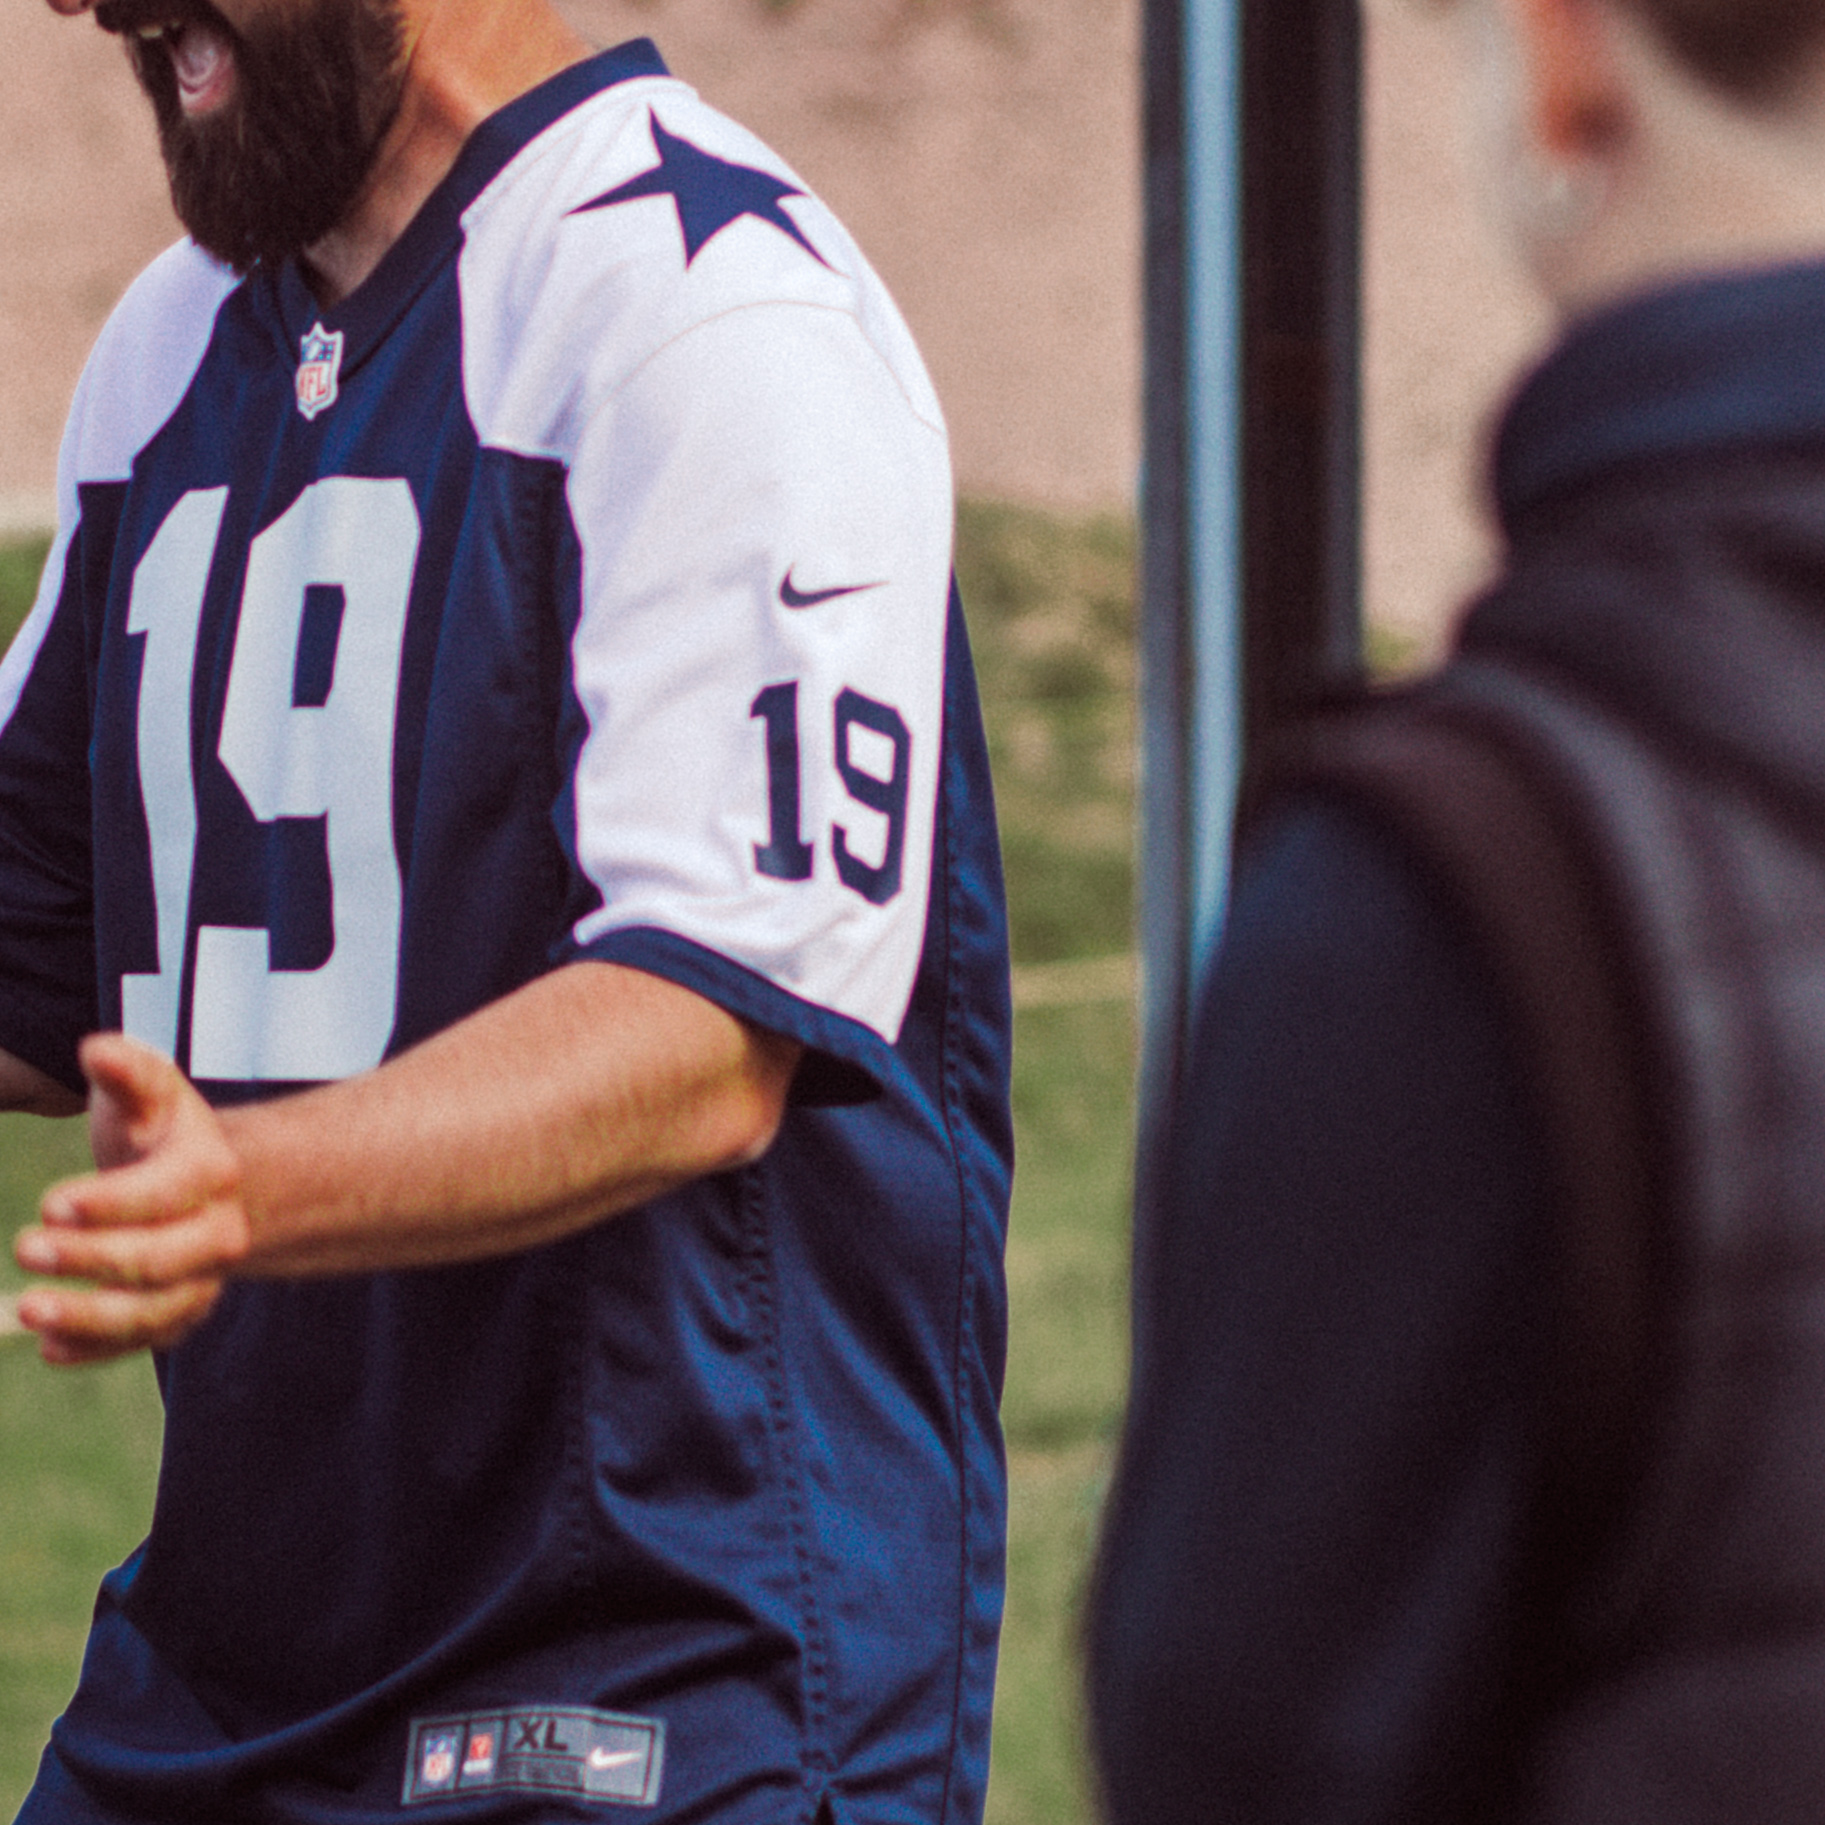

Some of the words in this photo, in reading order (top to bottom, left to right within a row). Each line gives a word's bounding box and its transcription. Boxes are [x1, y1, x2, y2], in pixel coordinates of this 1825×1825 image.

[122, 475, 424, 1081] 19
[749, 679, 912, 908] 19
[513, 1716, 569, 1752] XL
